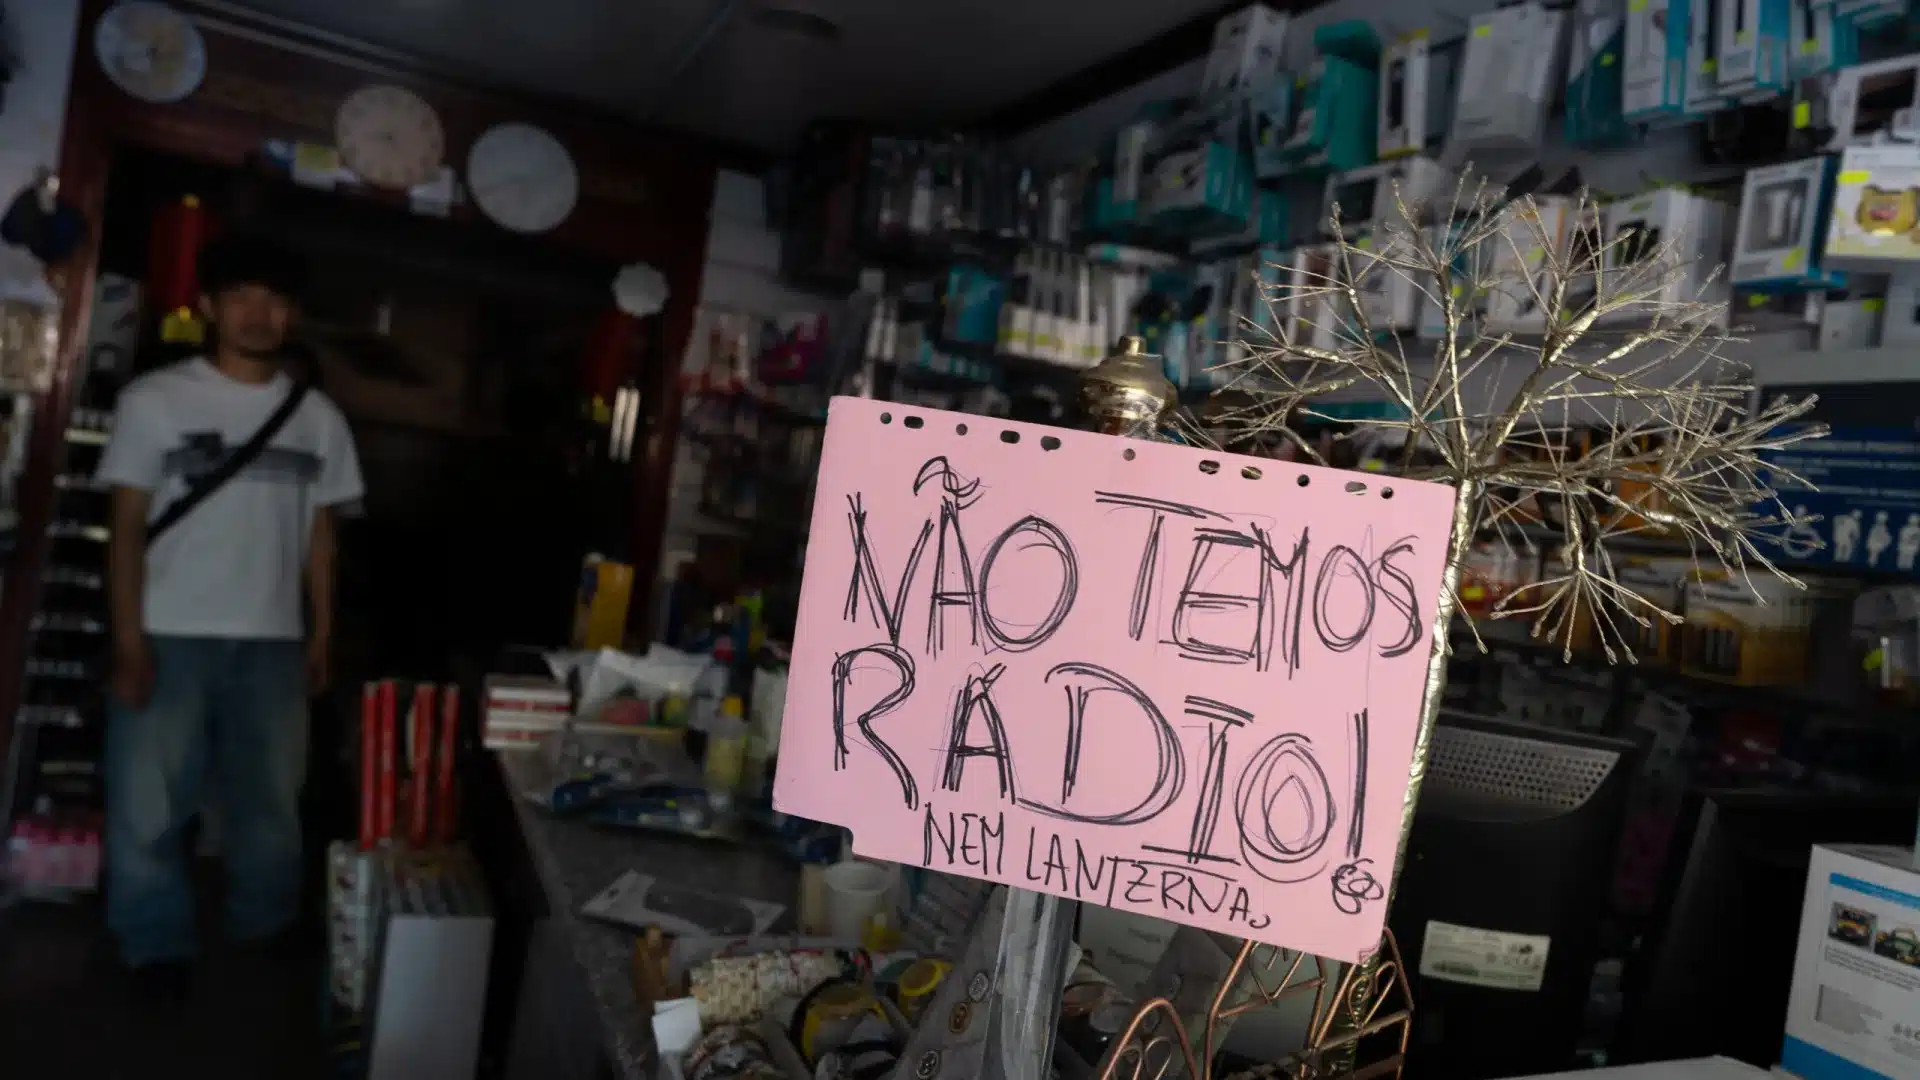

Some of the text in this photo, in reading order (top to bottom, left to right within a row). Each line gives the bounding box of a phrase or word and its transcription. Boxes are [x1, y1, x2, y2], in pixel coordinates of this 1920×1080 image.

[843, 455, 1423, 680] NÃO TEMOS
[831, 643, 1385, 914] RÁDIO!
[923, 802, 1004, 876] NEM
